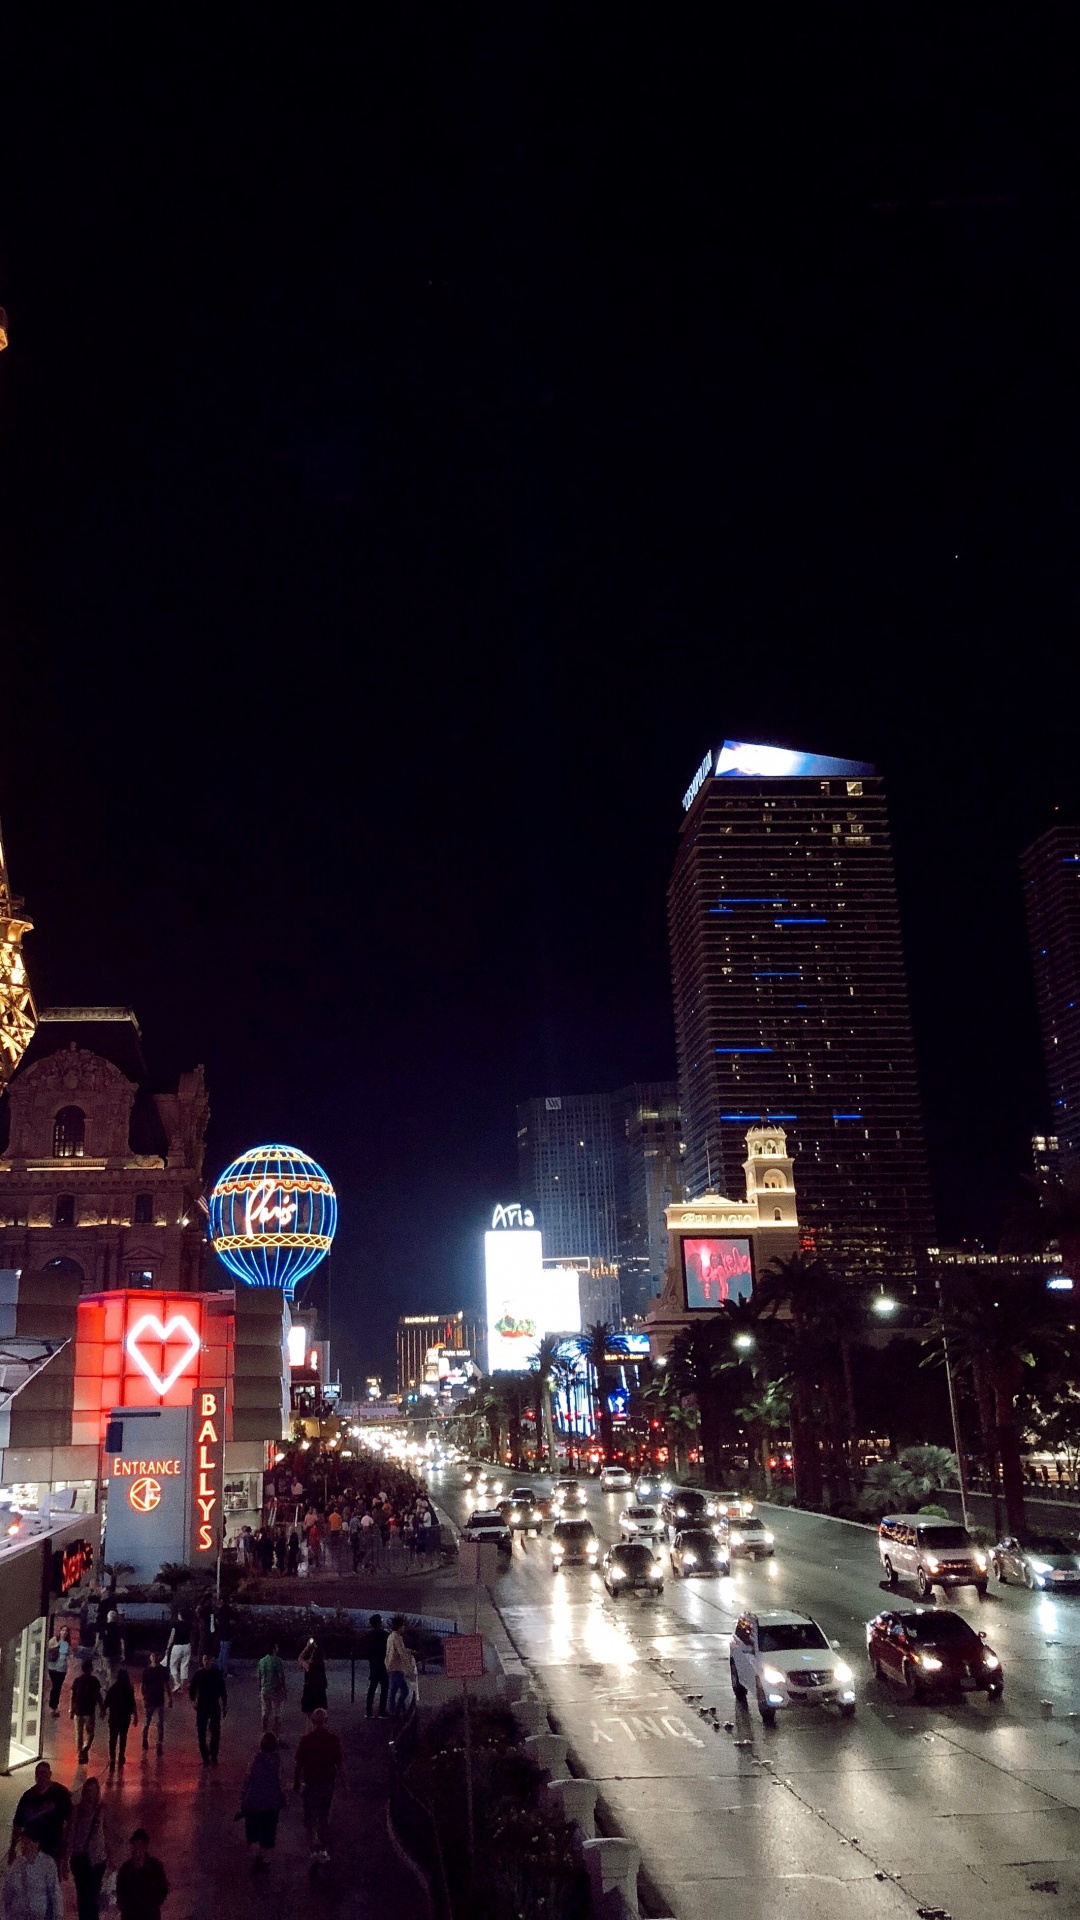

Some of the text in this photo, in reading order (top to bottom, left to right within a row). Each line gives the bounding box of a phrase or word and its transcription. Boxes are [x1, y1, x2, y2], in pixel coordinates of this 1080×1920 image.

[245, 1178, 298, 1240] Paris
[491, 1203, 535, 1229] Aria
[680, 1212, 752, 1224] BELLAGIO
[113, 1457, 181, 1476] ENTRANCE
[589, 1715, 705, 1748] ONLY
